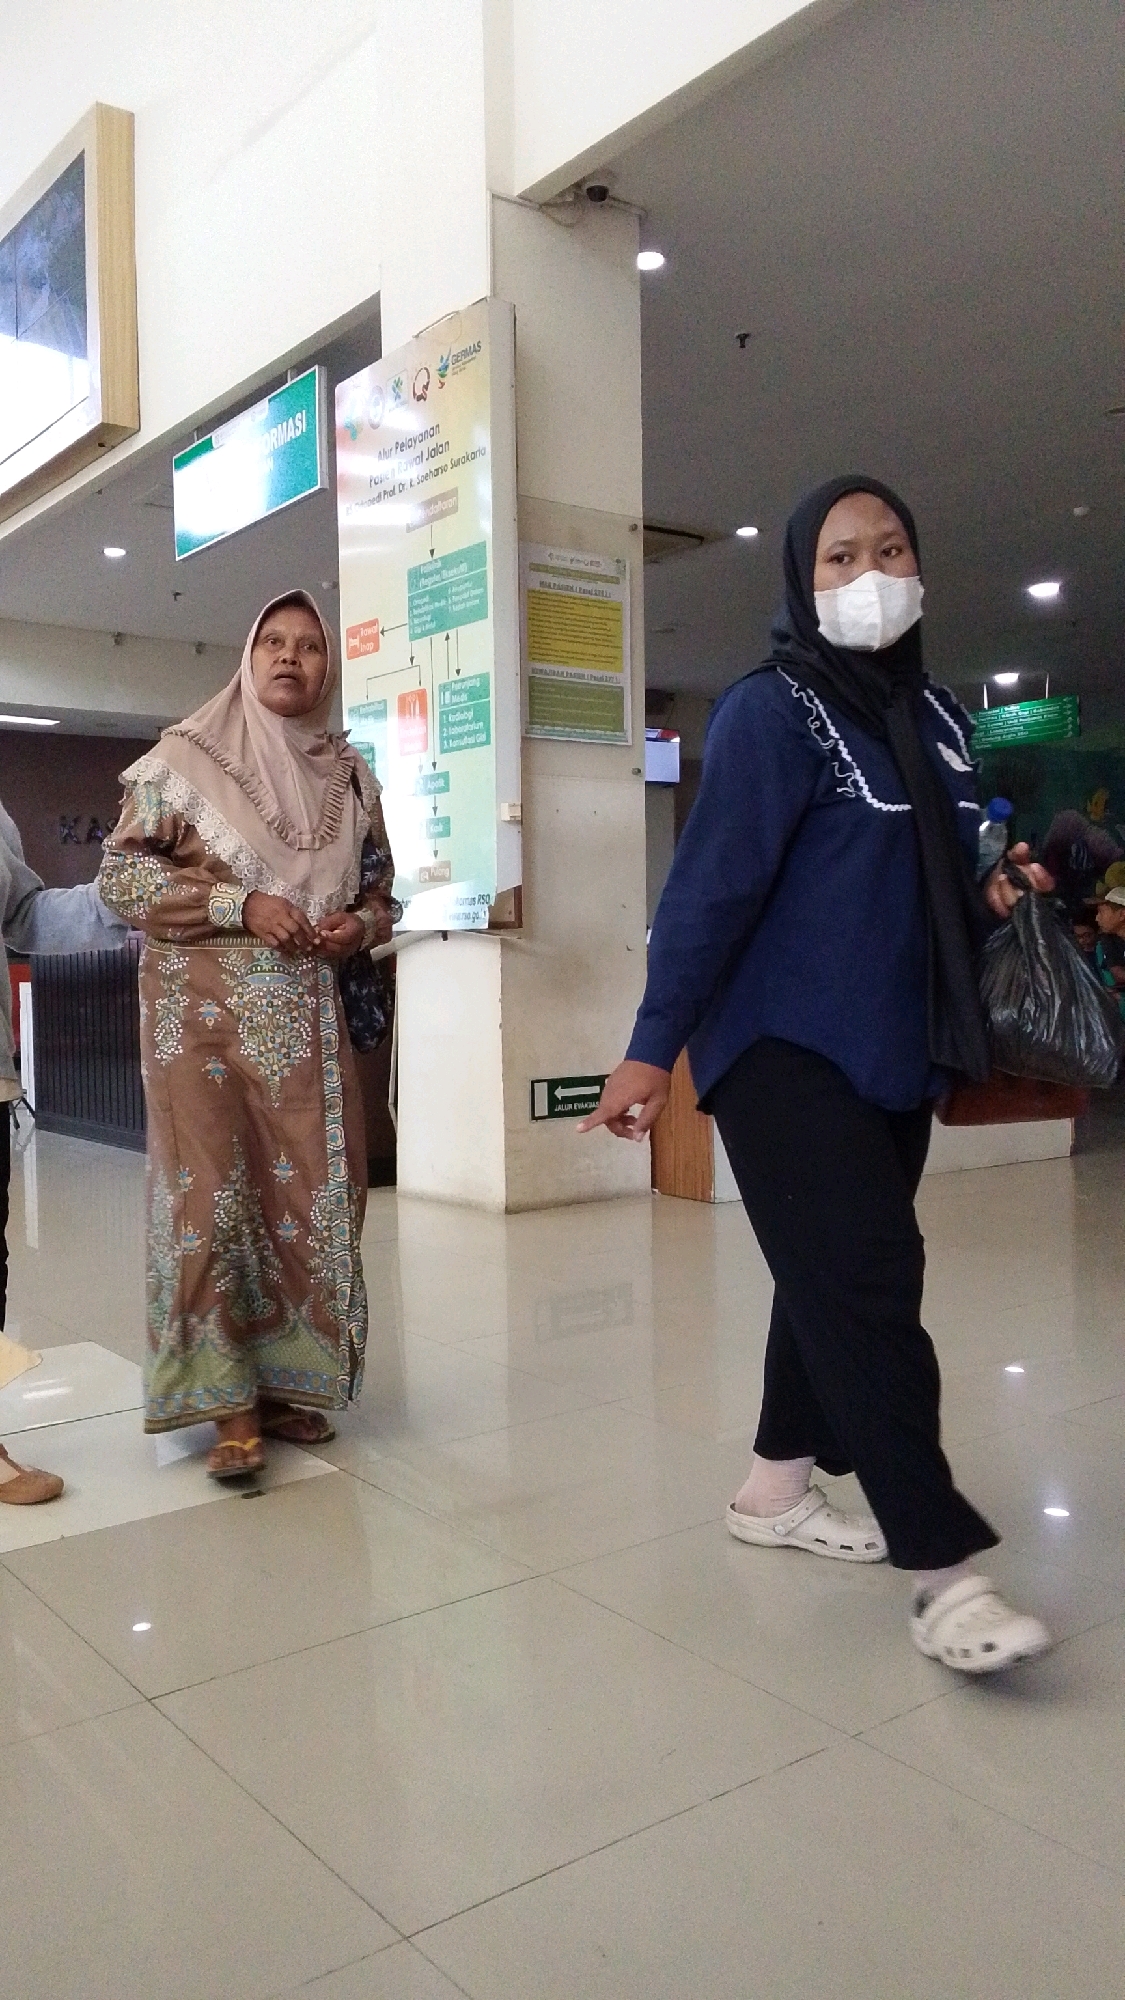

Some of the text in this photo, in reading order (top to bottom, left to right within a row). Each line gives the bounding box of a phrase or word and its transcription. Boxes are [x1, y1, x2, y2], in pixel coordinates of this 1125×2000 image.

[451, 340, 482, 366] GERMAS
[263, 409, 307, 456] ORMASI
[377, 423, 440, 462] Alur Pelayanan
[369, 468, 396, 489] Pasien
[425, 440, 451, 461] Jalan
[416, 463, 448, 485] Soeharso
[450, 446, 487, 470] Surakarta
[477, 893, 491, 905] RSO
[554, 1101, 600, 1112] JALUR EVAKUAS
